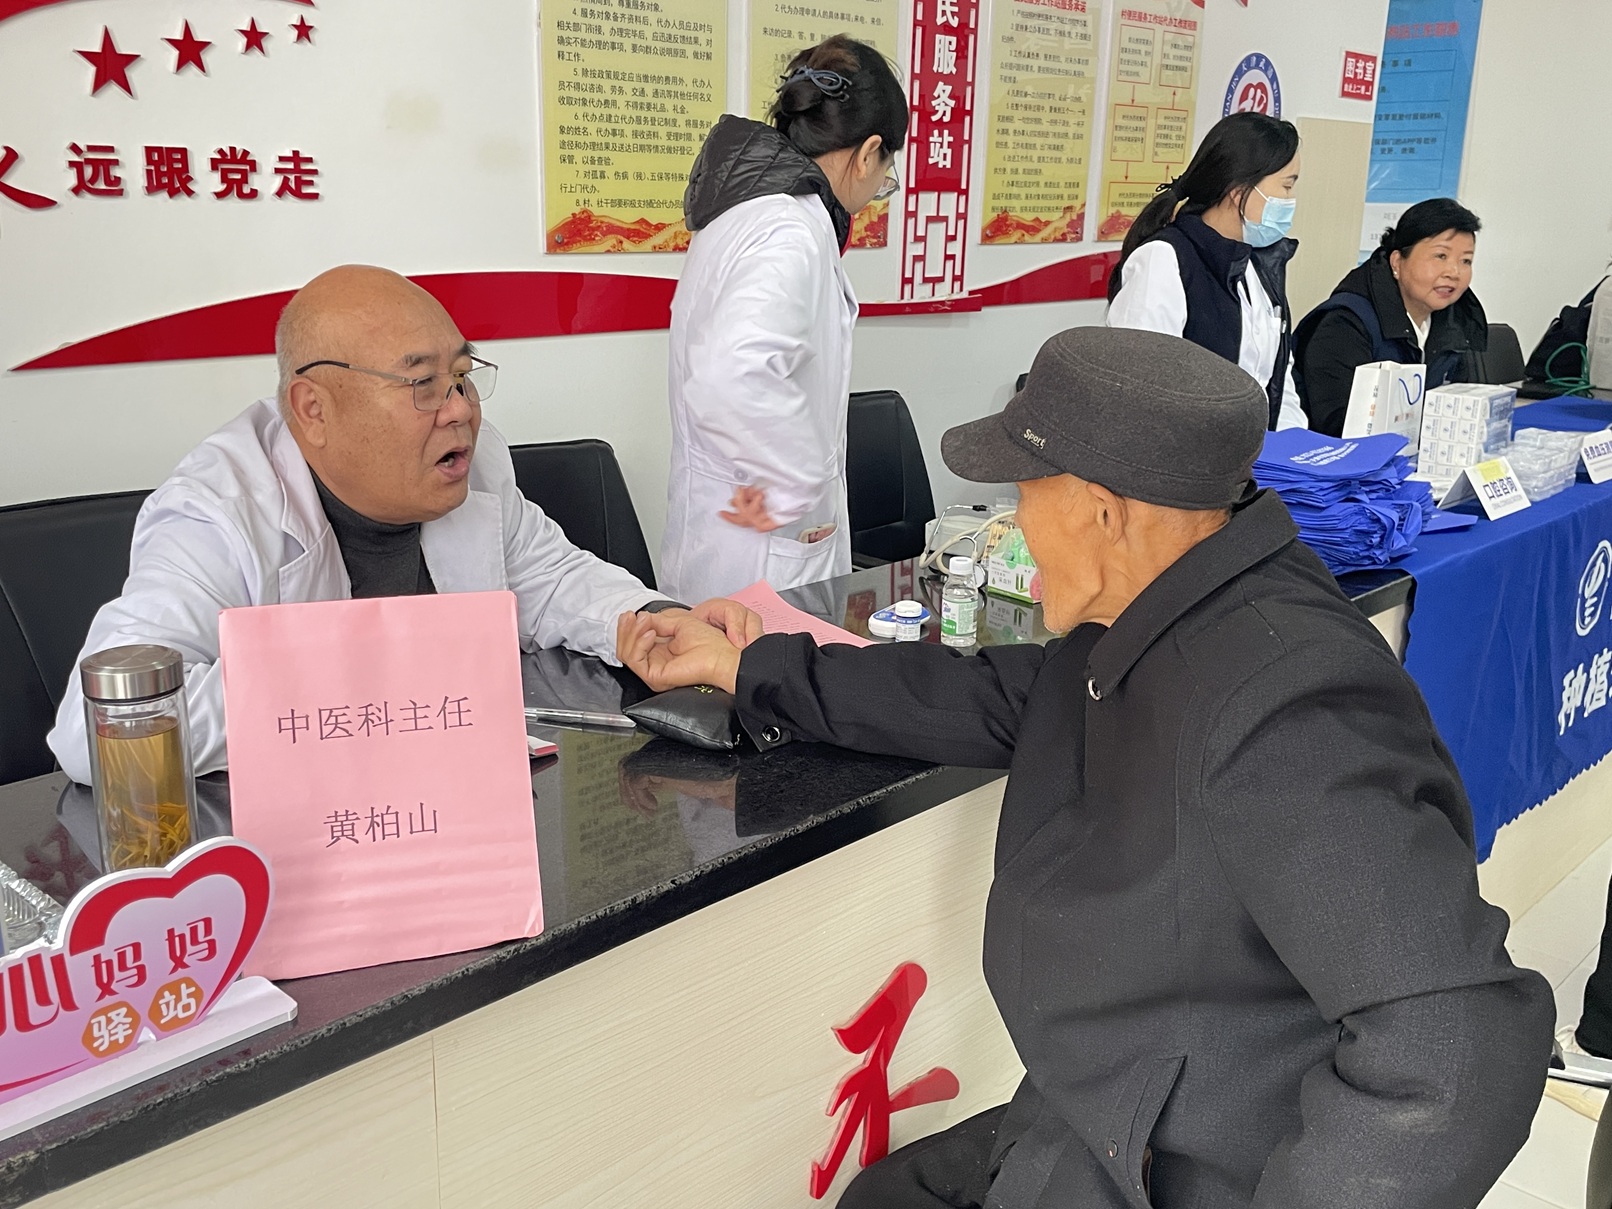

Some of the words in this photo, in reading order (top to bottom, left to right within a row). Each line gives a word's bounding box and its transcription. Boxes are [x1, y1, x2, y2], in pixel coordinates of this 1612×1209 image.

[557, 50, 585, 63] 释工作。
[928, 0, 959, 169] 民服务站
[558, 125, 708, 143] 象的姓名、代办事项、接收资料、受理时限、解
[1557, 647, 1612, 737] 种植
[277, 695, 474, 744] 中医科主任
[323, 802, 438, 848] 黄柏山
[90, 983, 197, 1052] 驿站
